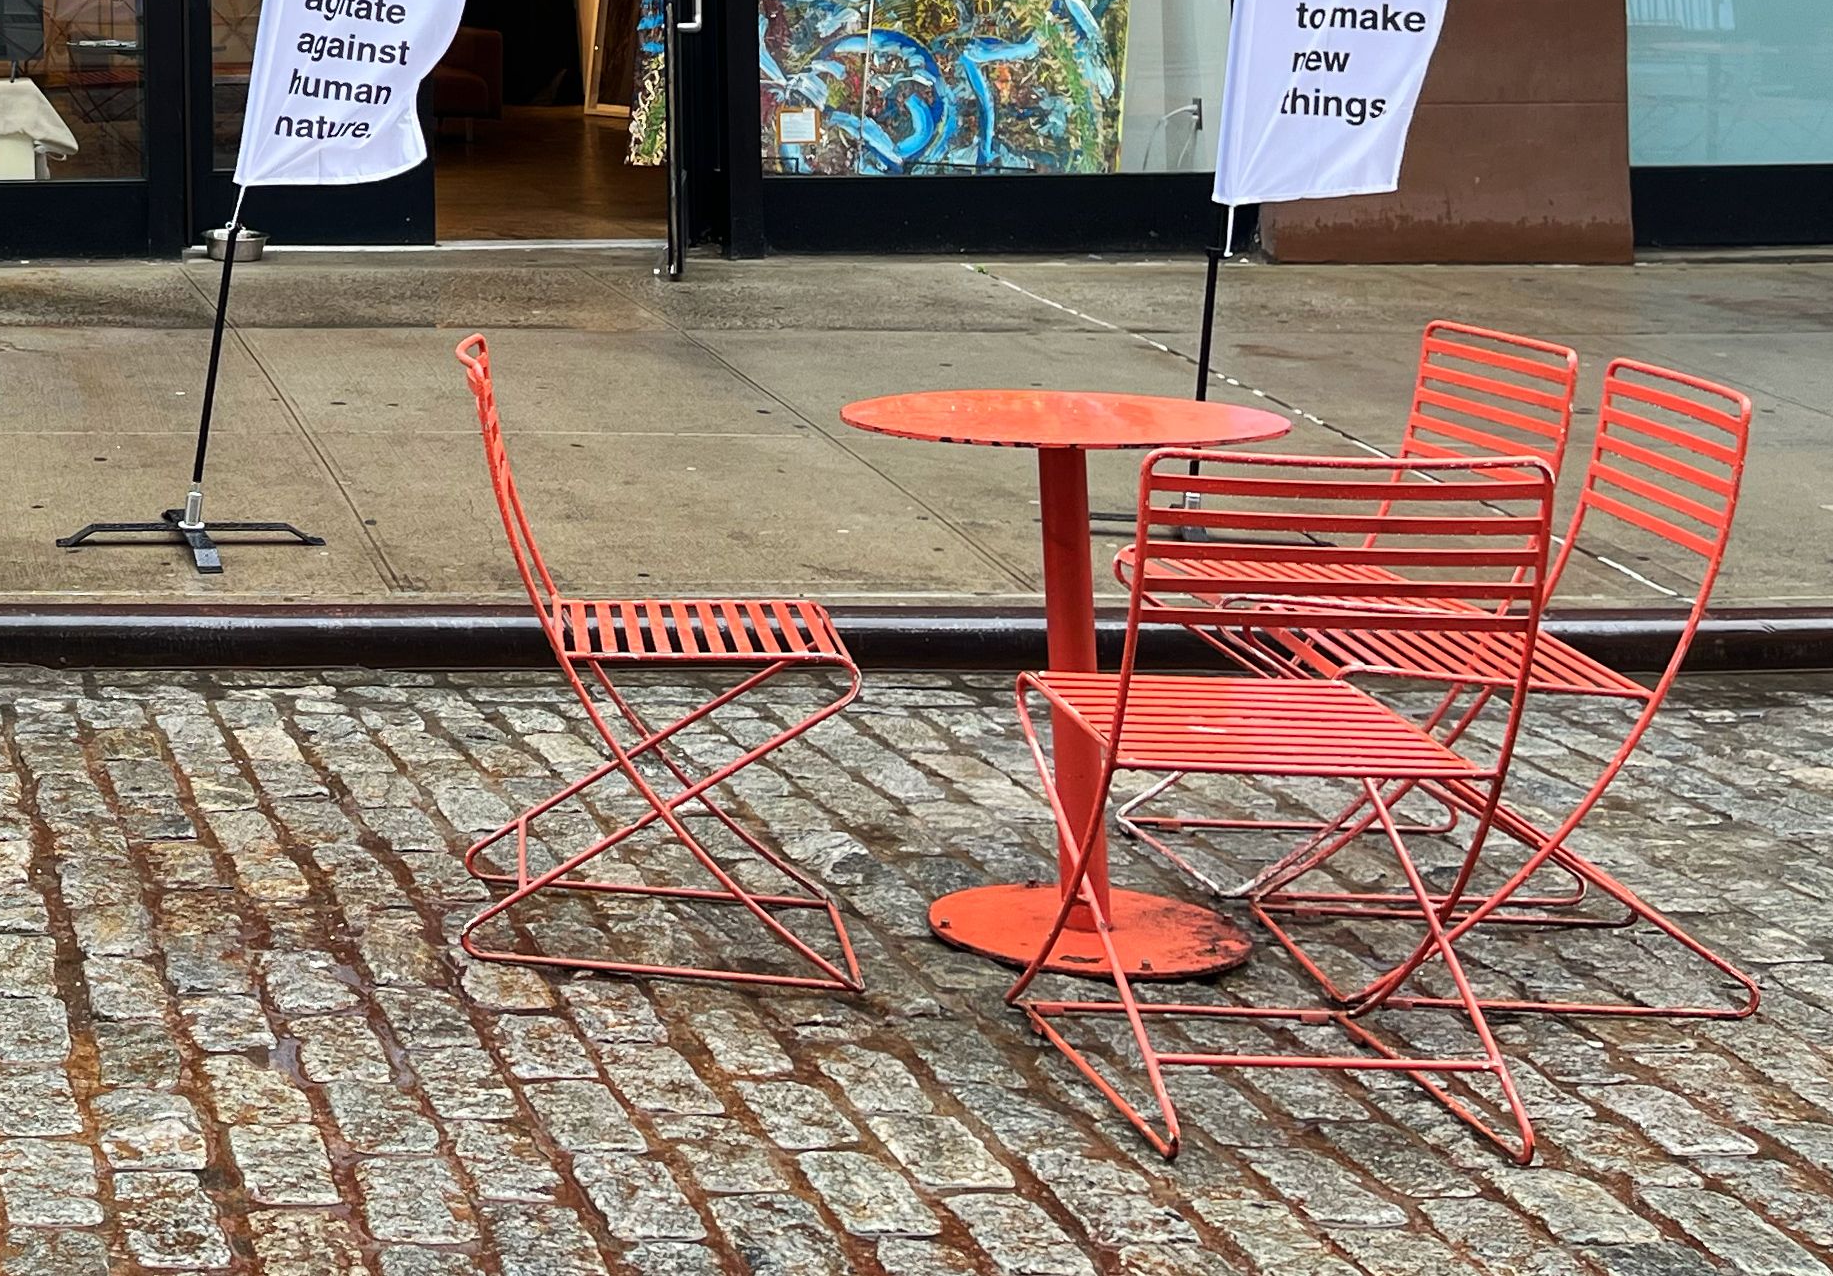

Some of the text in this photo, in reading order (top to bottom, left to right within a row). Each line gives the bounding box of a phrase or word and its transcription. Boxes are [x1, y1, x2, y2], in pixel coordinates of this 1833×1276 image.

[1295, 2, 1426, 33] to make
[296, 32, 410, 66] against
[288, 67, 392, 105] human
